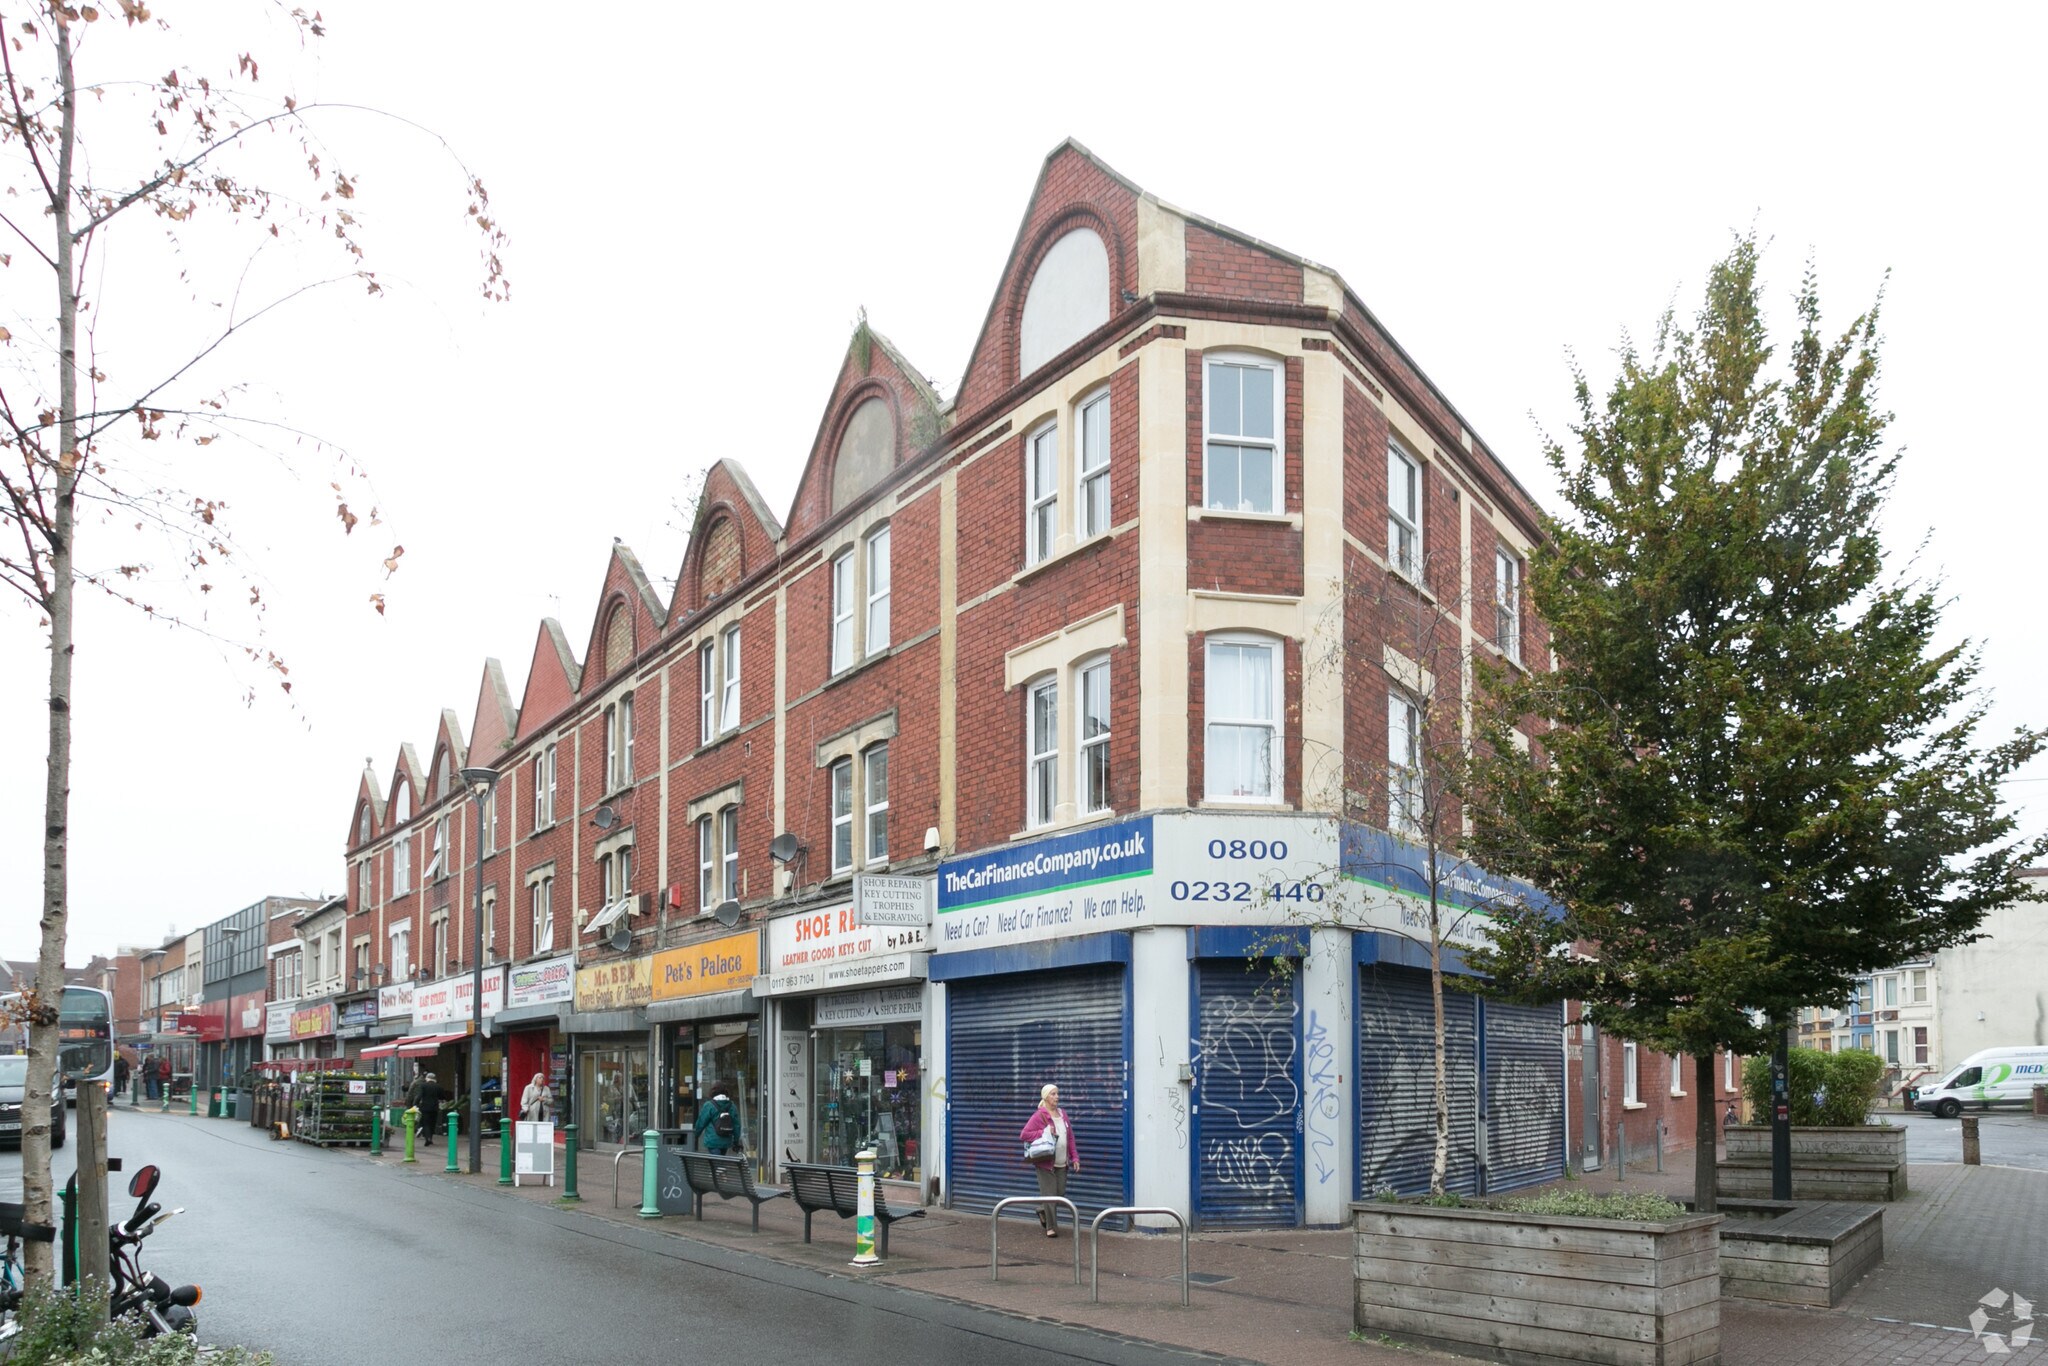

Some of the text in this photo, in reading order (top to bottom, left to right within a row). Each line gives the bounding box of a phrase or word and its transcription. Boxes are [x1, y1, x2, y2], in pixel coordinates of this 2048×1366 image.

[1208, 839, 1288, 860] 0800
[946, 831, 1145, 893] TheCarFinanceCompany.co.uk
[863, 878, 922, 889] SHOE REPAIRS
[1170, 880, 1324, 903] 0232 440
[864, 889, 922, 900] KEY CUTTING
[873, 901, 915, 911] TROPHIES
[944, 888, 1146, 942] Need a Car? Need Car Finance? We can Help.
[864, 913, 923, 922] & ENGRAVING
[795, 913, 831, 943] SHOE
[887, 936, 897, 949] by
[908, 932, 914, 943] &
[782, 939, 872, 966] LEATHER GOODS KEYS CUT
[611, 964, 636, 984] BEN
[665, 954, 742, 984] Pet's Palace
[828, 961, 905, 980] www.shoetappers.com
[771, 974, 814, 989] 0117 963 7104
[455, 982, 474, 1000] FRUIT
[887, 987, 920, 1001] WATCHES
[824, 1007, 865, 1020] KEY CUTTING
[880, 1003, 898, 1015] SHOE
